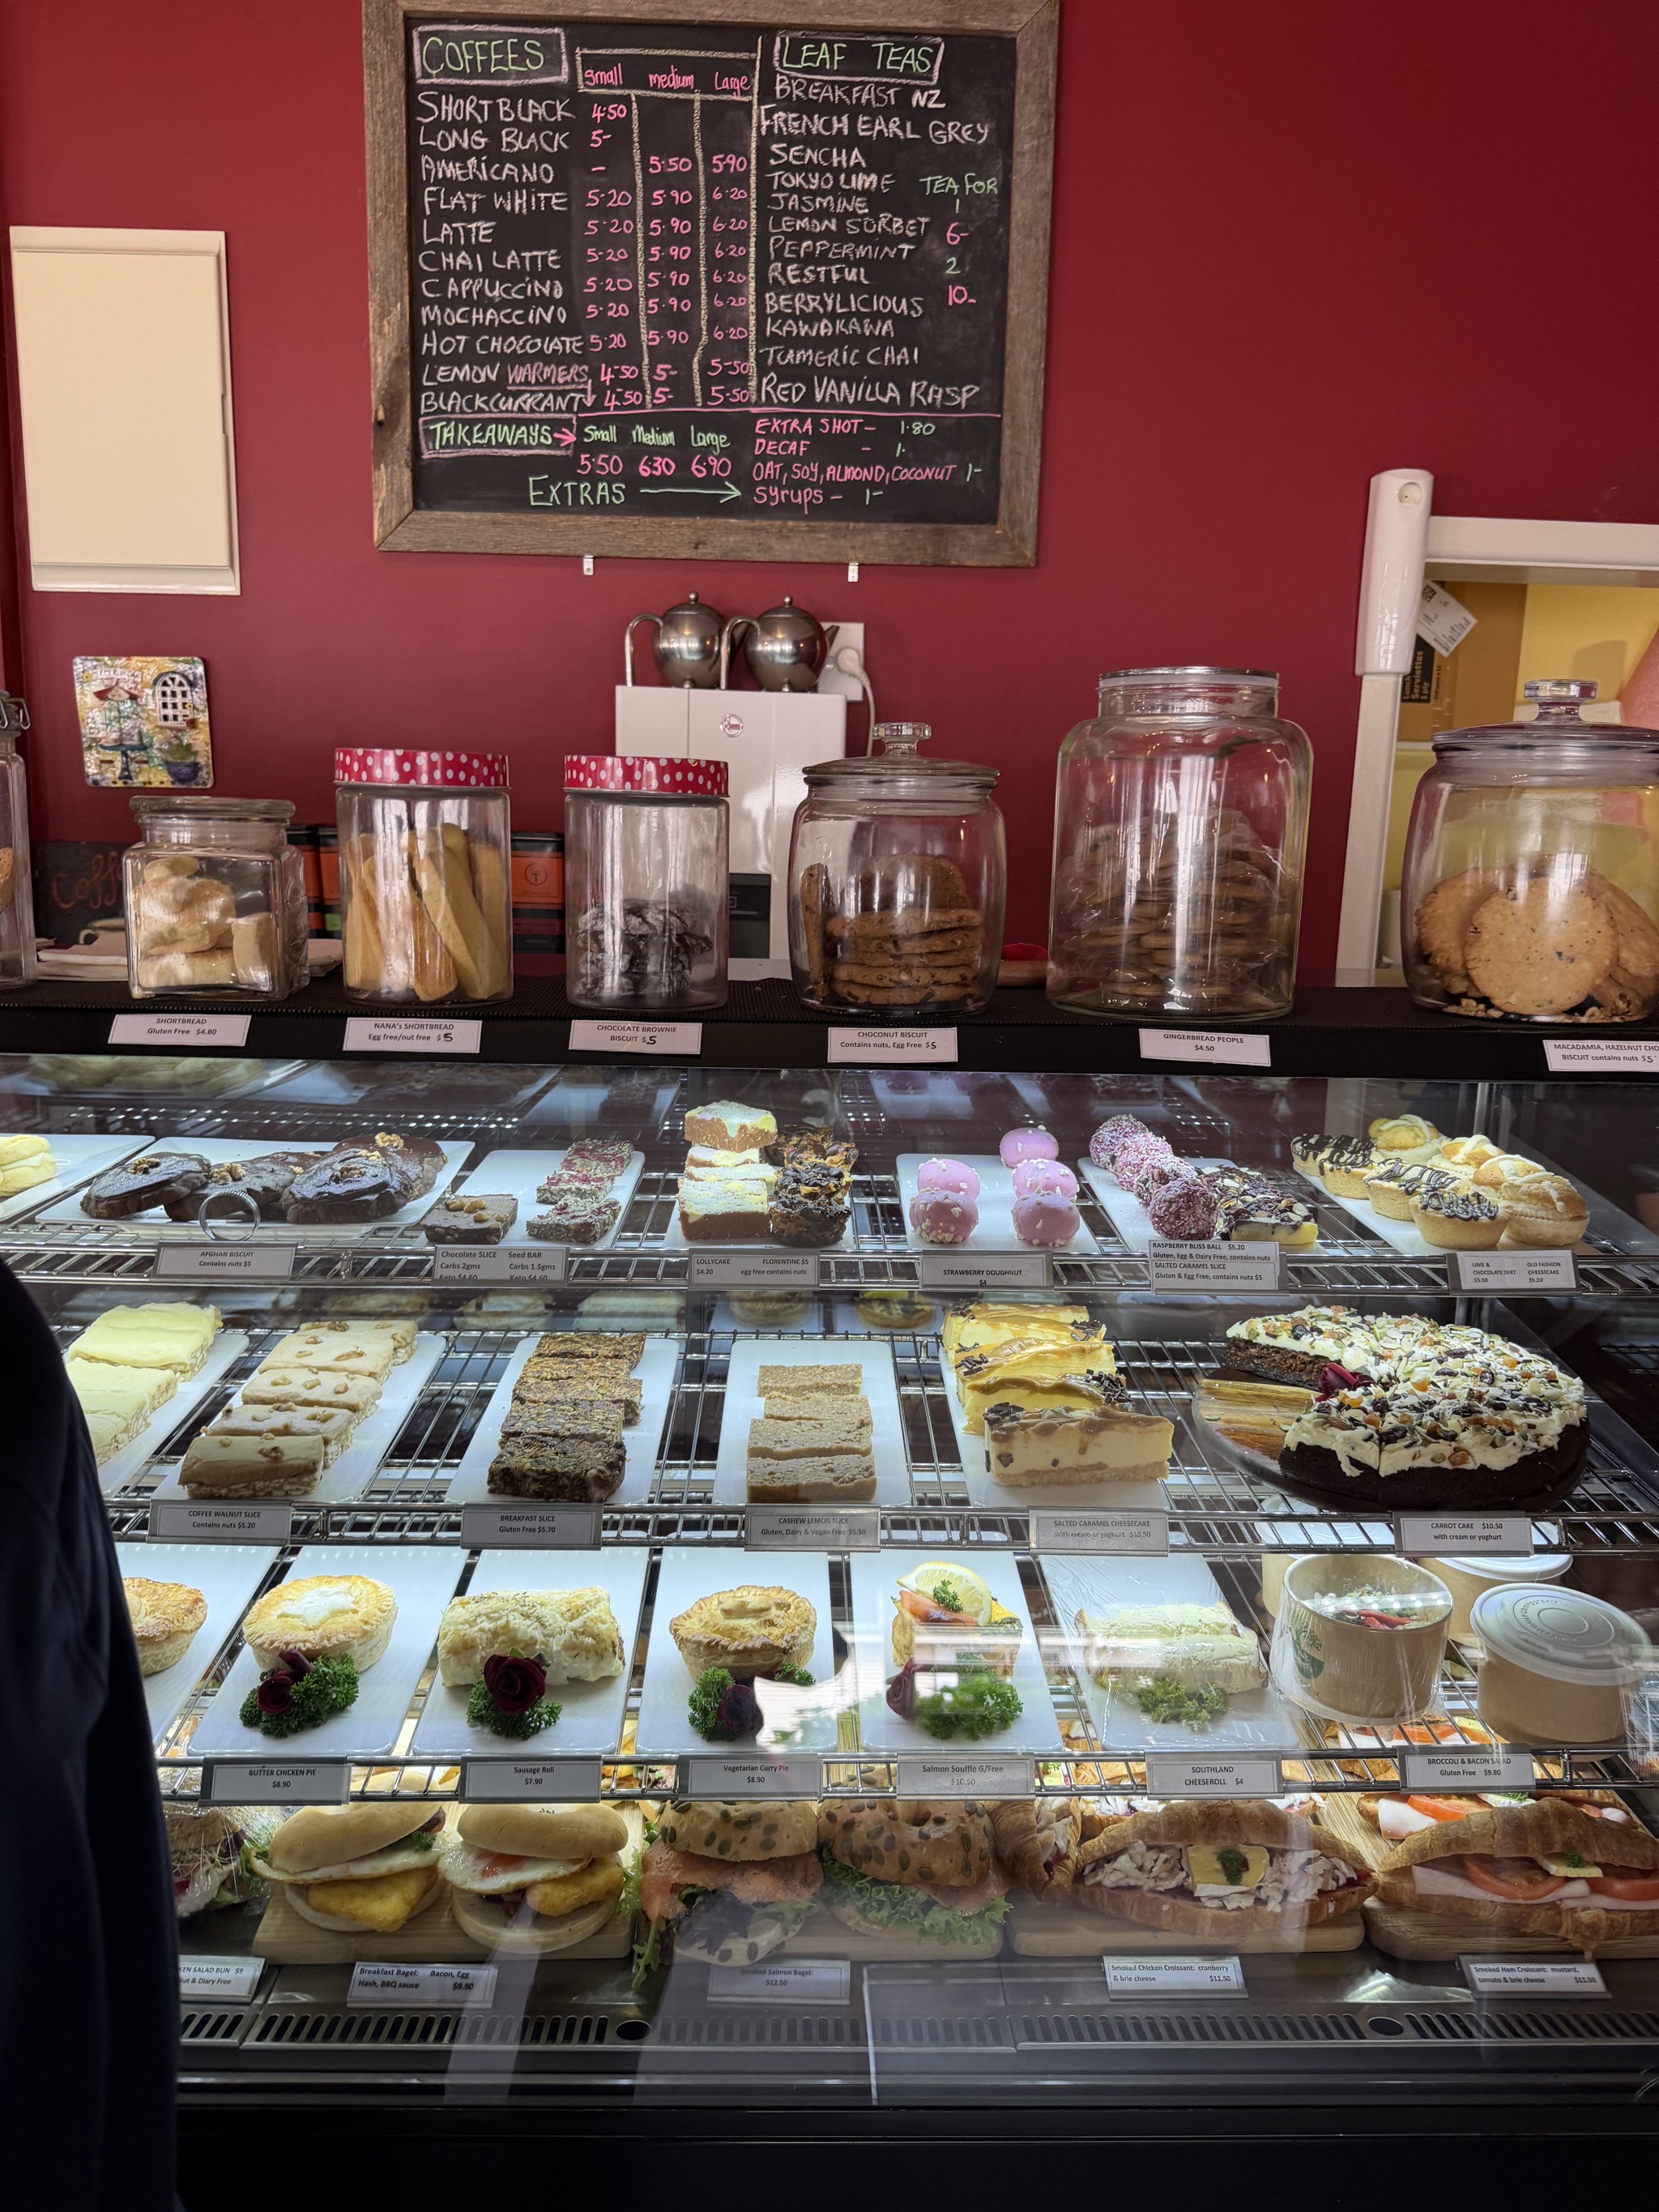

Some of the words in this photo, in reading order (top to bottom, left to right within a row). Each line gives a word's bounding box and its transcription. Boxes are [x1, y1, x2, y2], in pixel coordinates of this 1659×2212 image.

[422, 37, 544, 75] COFFEES
[782, 36, 847, 70] LEAF
[872, 42, 933, 73] TEAS
[649, 66, 694, 91] medium
[714, 72, 751, 100] Large
[775, 76, 905, 108] BREAKFAST
[911, 91, 945, 109] NZ
[416, 92, 493, 124] SHORT
[498, 97, 576, 122] BLACK
[759, 105, 848, 137] FRENCH
[857, 117, 922, 139] EARL
[928, 122, 989, 144] GREY
[419, 126, 488, 151] LONG
[501, 127, 570, 153] BLACK
[769, 143, 866, 168] SENCHA
[765, 171, 833, 191] TOKYO
[839, 173, 896, 194] LIME
[919, 176, 958, 196] TEA
[965, 173, 998, 194] FOR
[424, 187, 486, 215] FLAT
[423, 220, 497, 245] LATTE
[769, 215, 837, 233] LEMON
[846, 213, 931, 237] SORBET
[418, 250, 482, 271] CHAI
[492, 250, 562, 271] LATTE
[767, 263, 872, 285] RESTFUL
[765, 293, 923, 317] BERRYLICIOUS
[766, 318, 894, 337] KAWAKAWA
[421, 331, 469, 356] HOT
[476, 335, 584, 354] CHOCOLATE
[867, 348, 919, 365] CHAI
[422, 364, 499, 386] LEMON
[506, 364, 588, 384] WARMERS
[761, 372, 805, 404] RED
[813, 376, 900, 405] VANILLA
[911, 381, 979, 408] RASP
[420, 391, 582, 414] BLACKCURRANT
[430, 422, 552, 450] TAKEAWAYS
[754, 420, 812, 434] EXTRA
[583, 425, 616, 443] Small
[632, 427, 676, 446] Medium
[690, 426, 731, 455] Large
[754, 441, 810, 455] DECAF
[891, 465, 957, 481] COCONUT
[528, 475, 625, 506] EXTRAS
[597, 1024, 640, 1032] CHOCOLATE
[1164, 1034, 1215, 1042] GINGERBREAD
[760, 1765, 778, 1773] Curry
